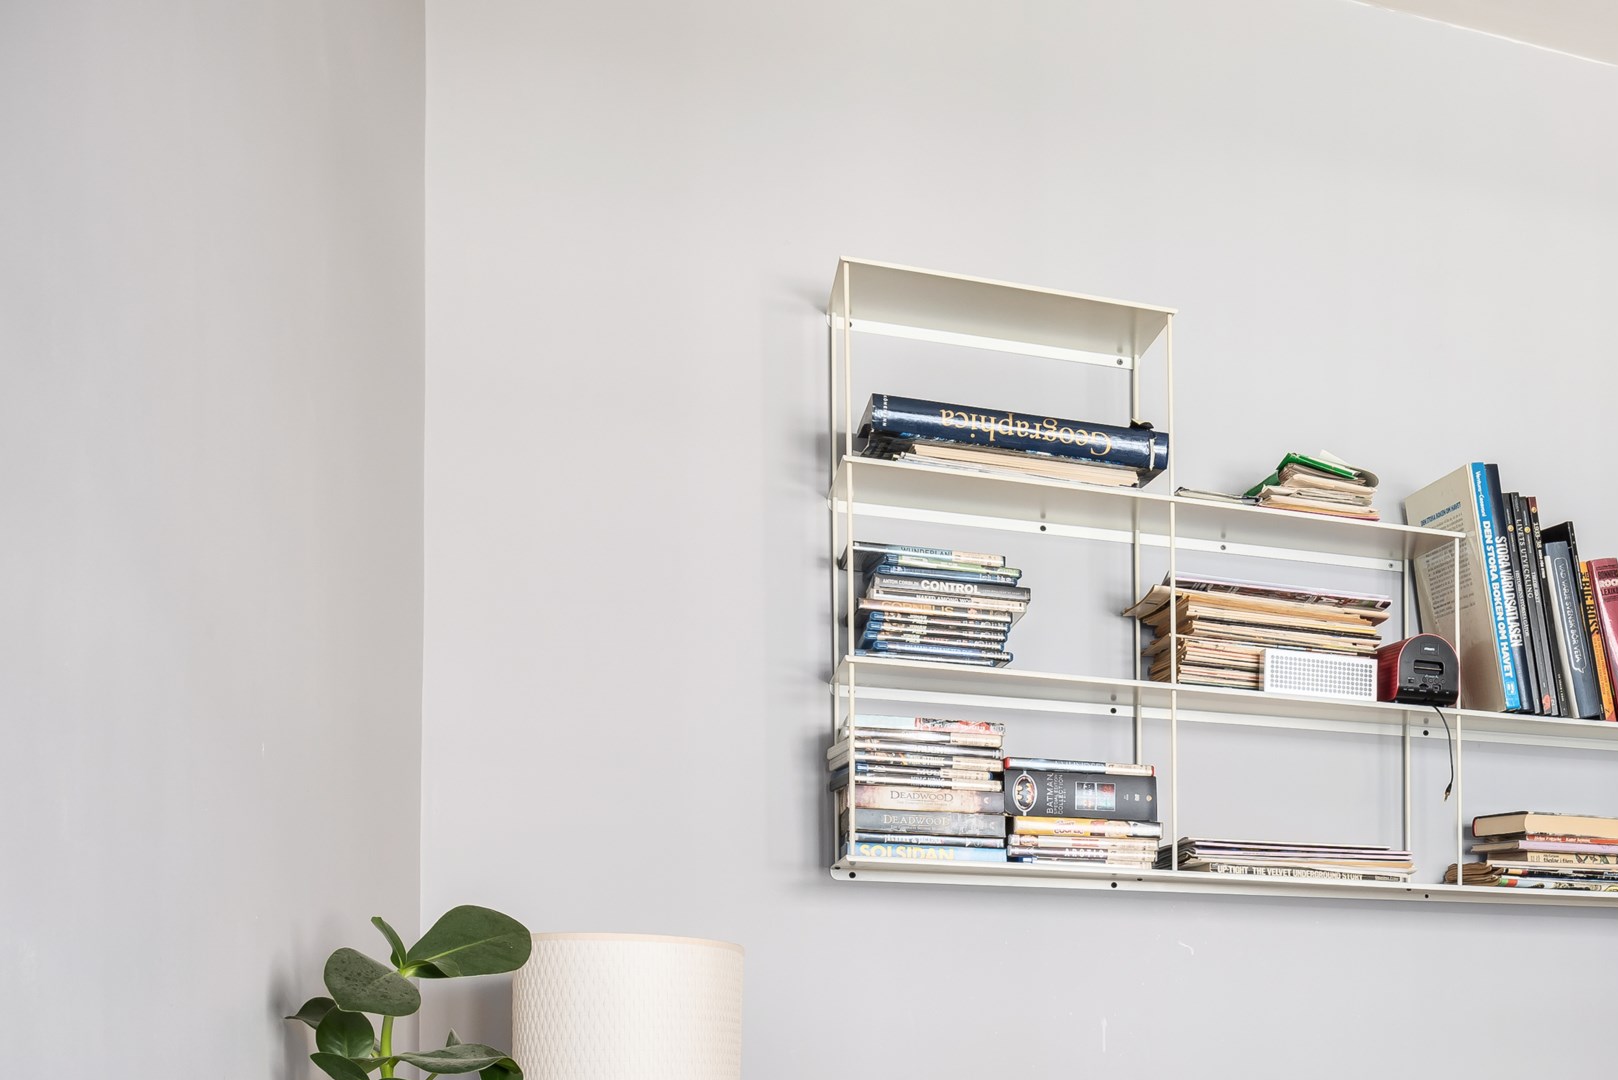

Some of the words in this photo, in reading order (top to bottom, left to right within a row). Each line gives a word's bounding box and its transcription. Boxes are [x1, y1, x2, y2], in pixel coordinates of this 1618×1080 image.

[939, 408, 1112, 456] Geographica
[1482, 520, 1494, 544] DEN
[1486, 545, 1499, 577] STORA
[1495, 536, 1511, 568] STORA
[1516, 519, 1525, 547] LIVETS
[1521, 548, 1534, 599] UTVECKLING
[1558, 564, 1566, 579] VAD
[920, 579, 981, 594] CONTROL
[1491, 581, 1505, 621] BOKEN
[1501, 569, 1523, 648] VÄRLDSATLASEN
[1565, 600, 1576, 629] SVENSK
[1497, 622, 1507, 640] OM
[1570, 629, 1579, 645] BÖR
[1500, 641, 1513, 679] HAVET
[1572, 645, 1582, 663] VETA
[890, 790, 954, 802] DEADWOOD
[1046, 773, 1054, 814] BATMAN
[883, 814, 950, 825] DEADWOOD
[860, 843, 955, 860] SOLSIDAN
[1217, 865, 1249, 874] UP-TIGHT
[1252, 867, 1266, 875] THE
[1267, 868, 1292, 877] VELVET
[1293, 869, 1341, 880] UNDERGROUND
